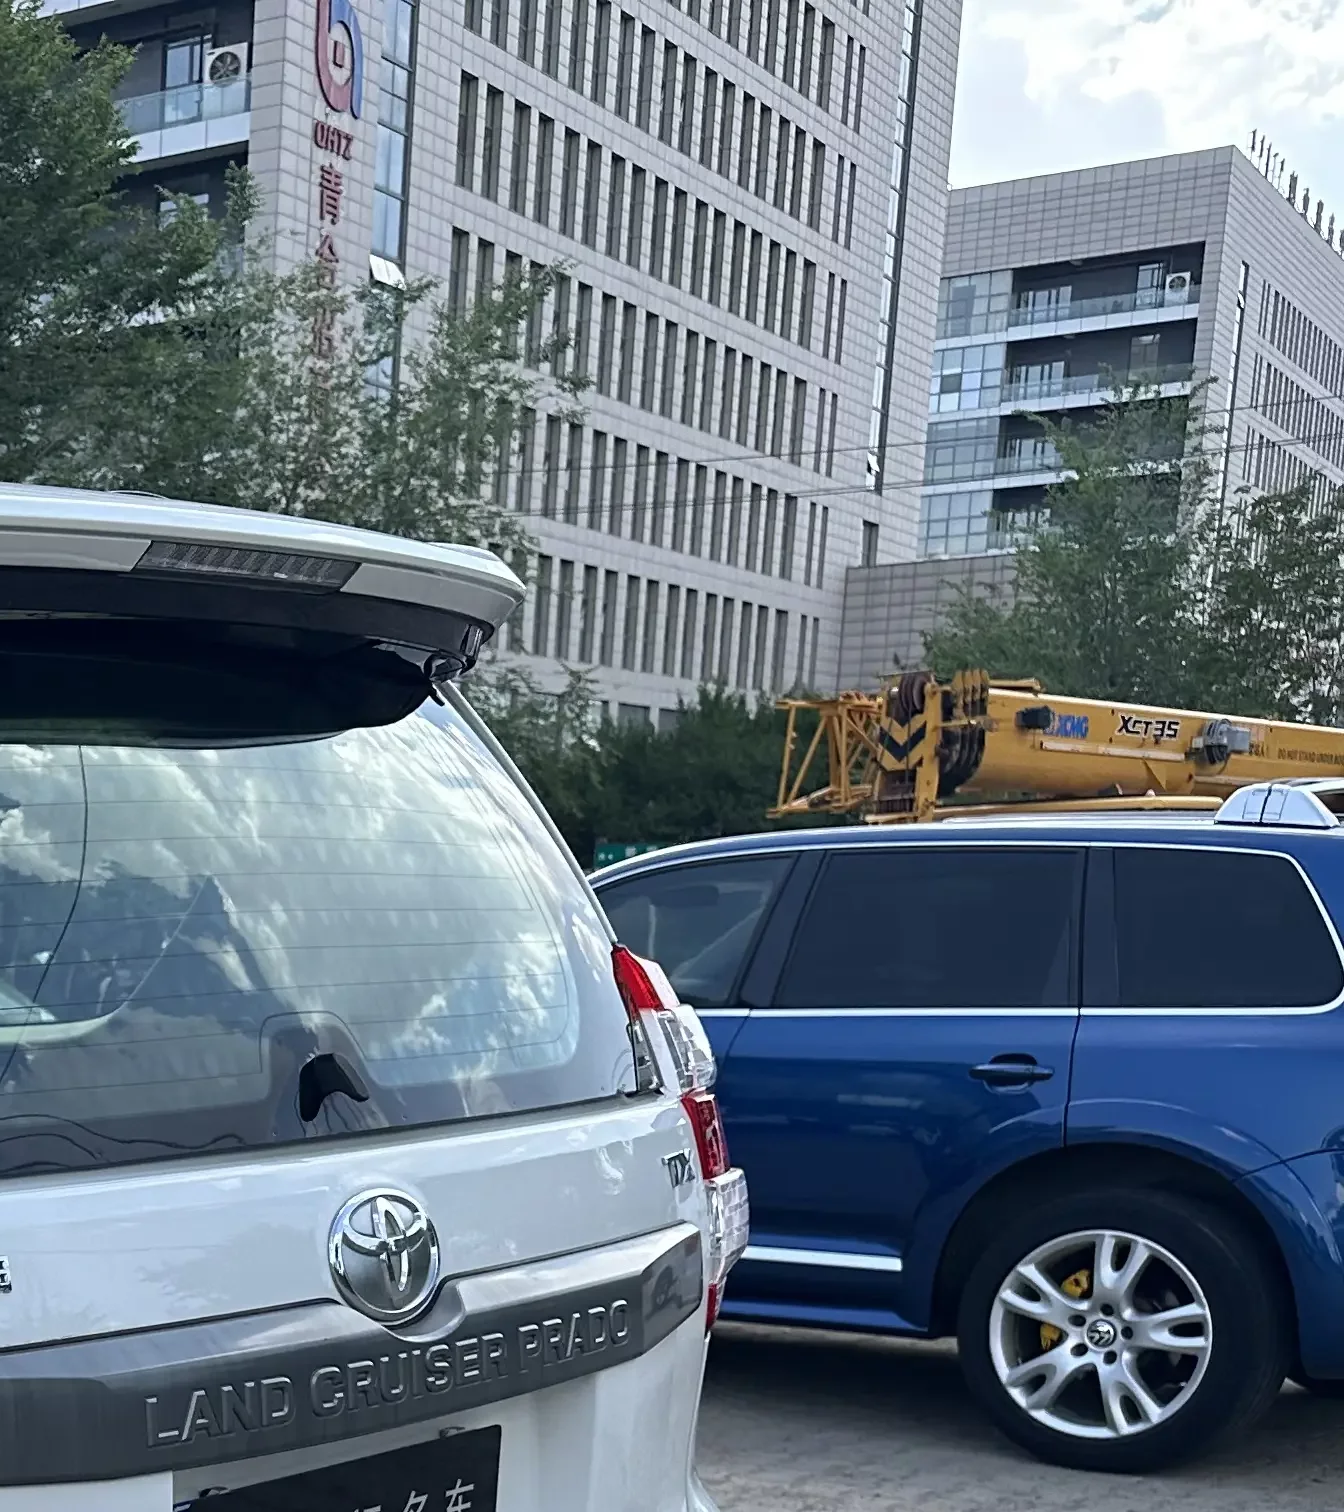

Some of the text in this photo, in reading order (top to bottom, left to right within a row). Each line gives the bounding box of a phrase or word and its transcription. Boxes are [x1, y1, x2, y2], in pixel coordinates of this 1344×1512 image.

[1056, 713, 1090, 740] XCMG
[1115, 713, 1182, 740] XCT35
[144, 1299, 631, 1448] LAND CRUISER PRADO
